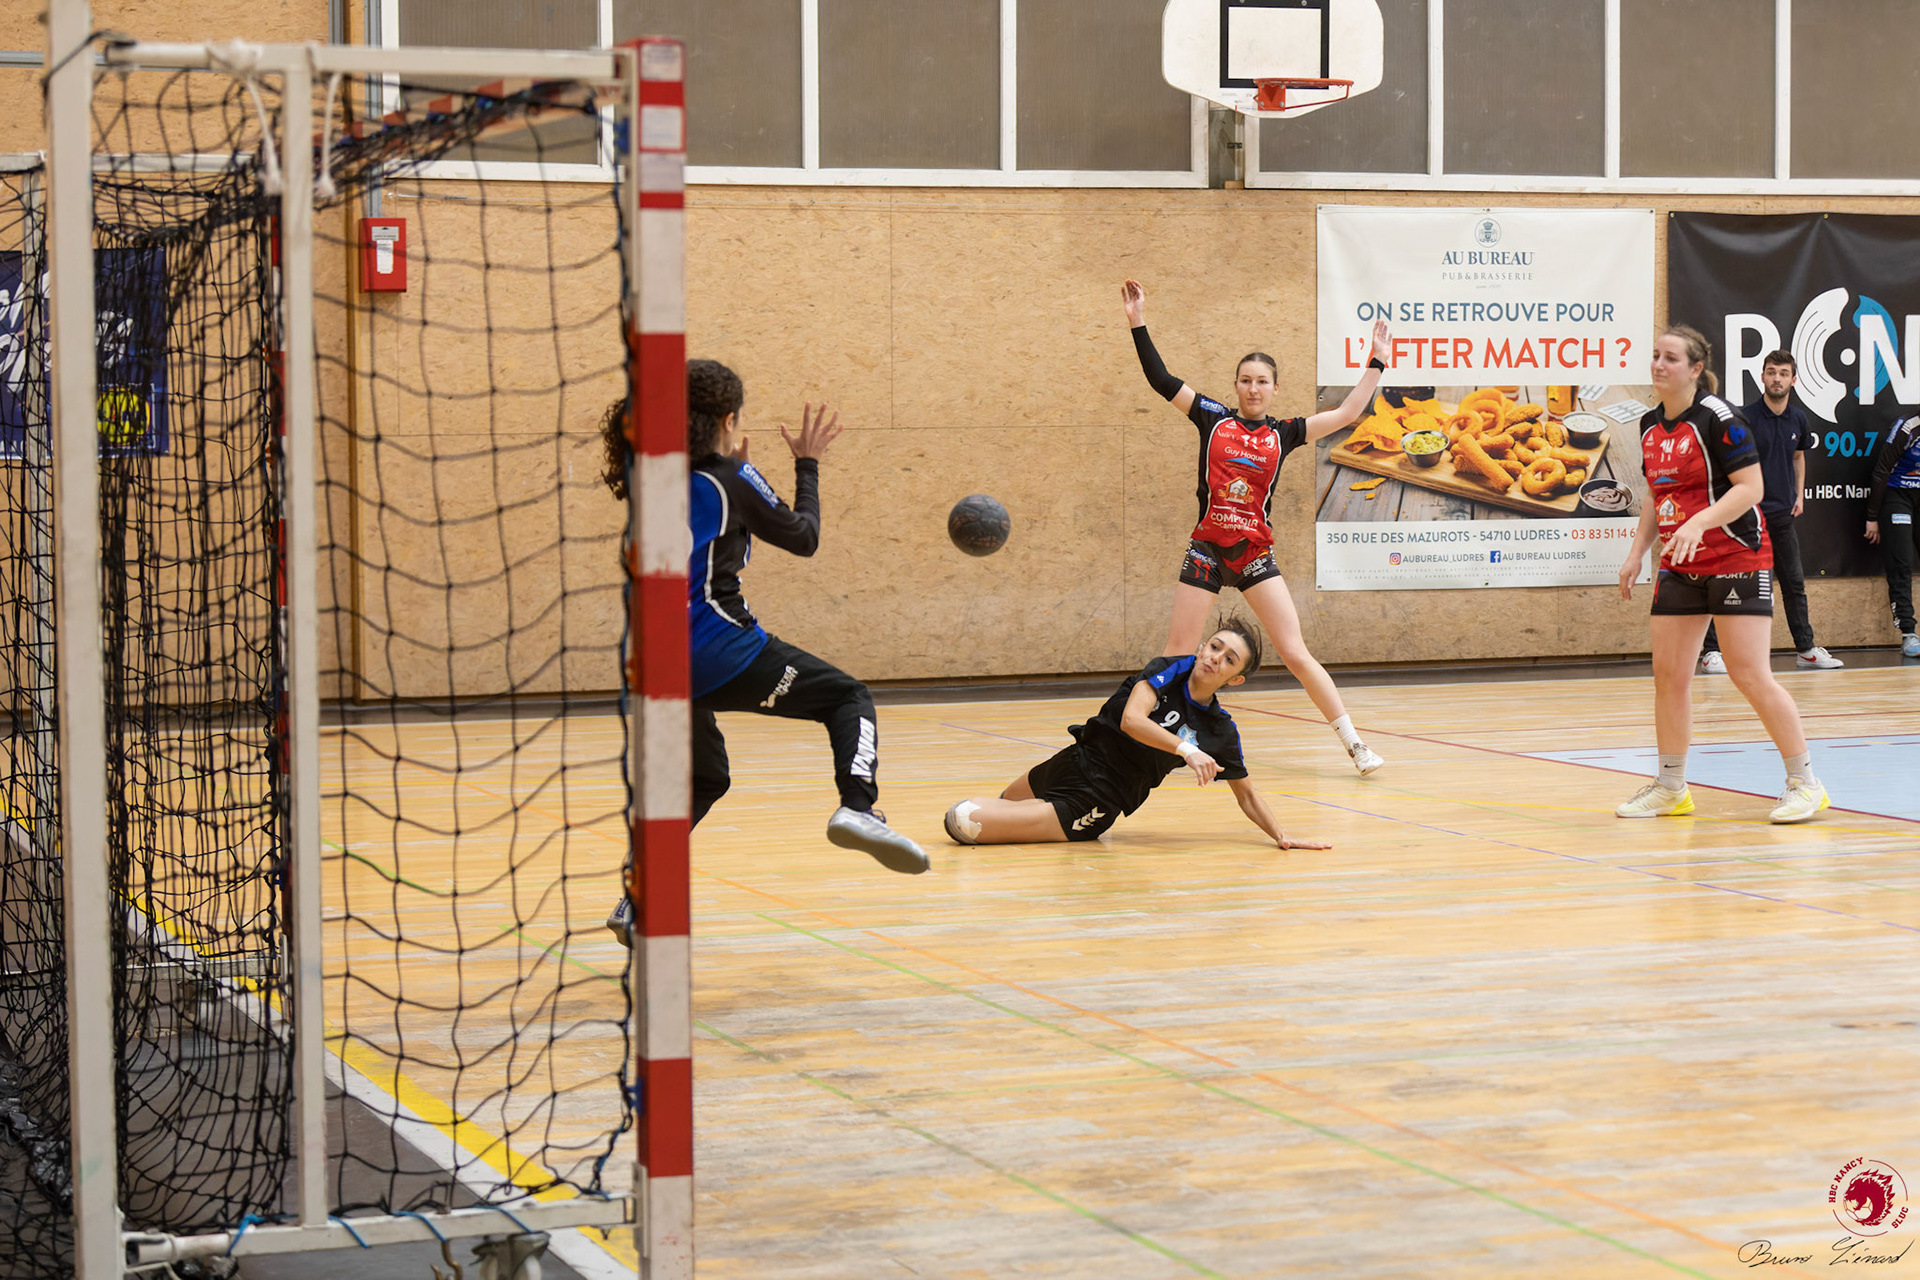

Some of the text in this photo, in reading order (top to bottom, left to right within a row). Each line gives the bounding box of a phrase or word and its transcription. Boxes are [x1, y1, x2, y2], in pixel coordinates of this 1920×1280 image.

[1442, 251, 1534, 265] AU BUREAU
[1442, 272, 1533, 280] PUB&BRASSERIE
[1357, 302, 1614, 322] ON SE RETROUVE POUR
[1483, 338, 1605, 368] MATCH
[1615, 337, 1632, 368] ?
[1824, 431, 1879, 457] 90.7
[1224, 446, 1267, 463] Guy Hoquet
[1816, 485, 1842, 499] HBC
[1327, 533, 1348, 544] 350
[1352, 532, 1377, 544] RUE
[1381, 532, 1404, 543] DES
[1408, 530, 1470, 543] MAZUROTS
[1480, 530, 1511, 542] 54710
[1514, 529, 1560, 541] LUDRES
[1571, 529, 1586, 539] 03
[1588, 528, 1602, 539] 83
[1604, 528, 1614, 539] 51
[1617, 528, 1627, 538] 14
[1629, 528, 1637, 538] 6
[1502, 552, 1514, 561] AU
[1516, 552, 1550, 561] BUREAU
[1553, 551, 1586, 560] LUDRES
[1159, 710, 1180, 727] 9
